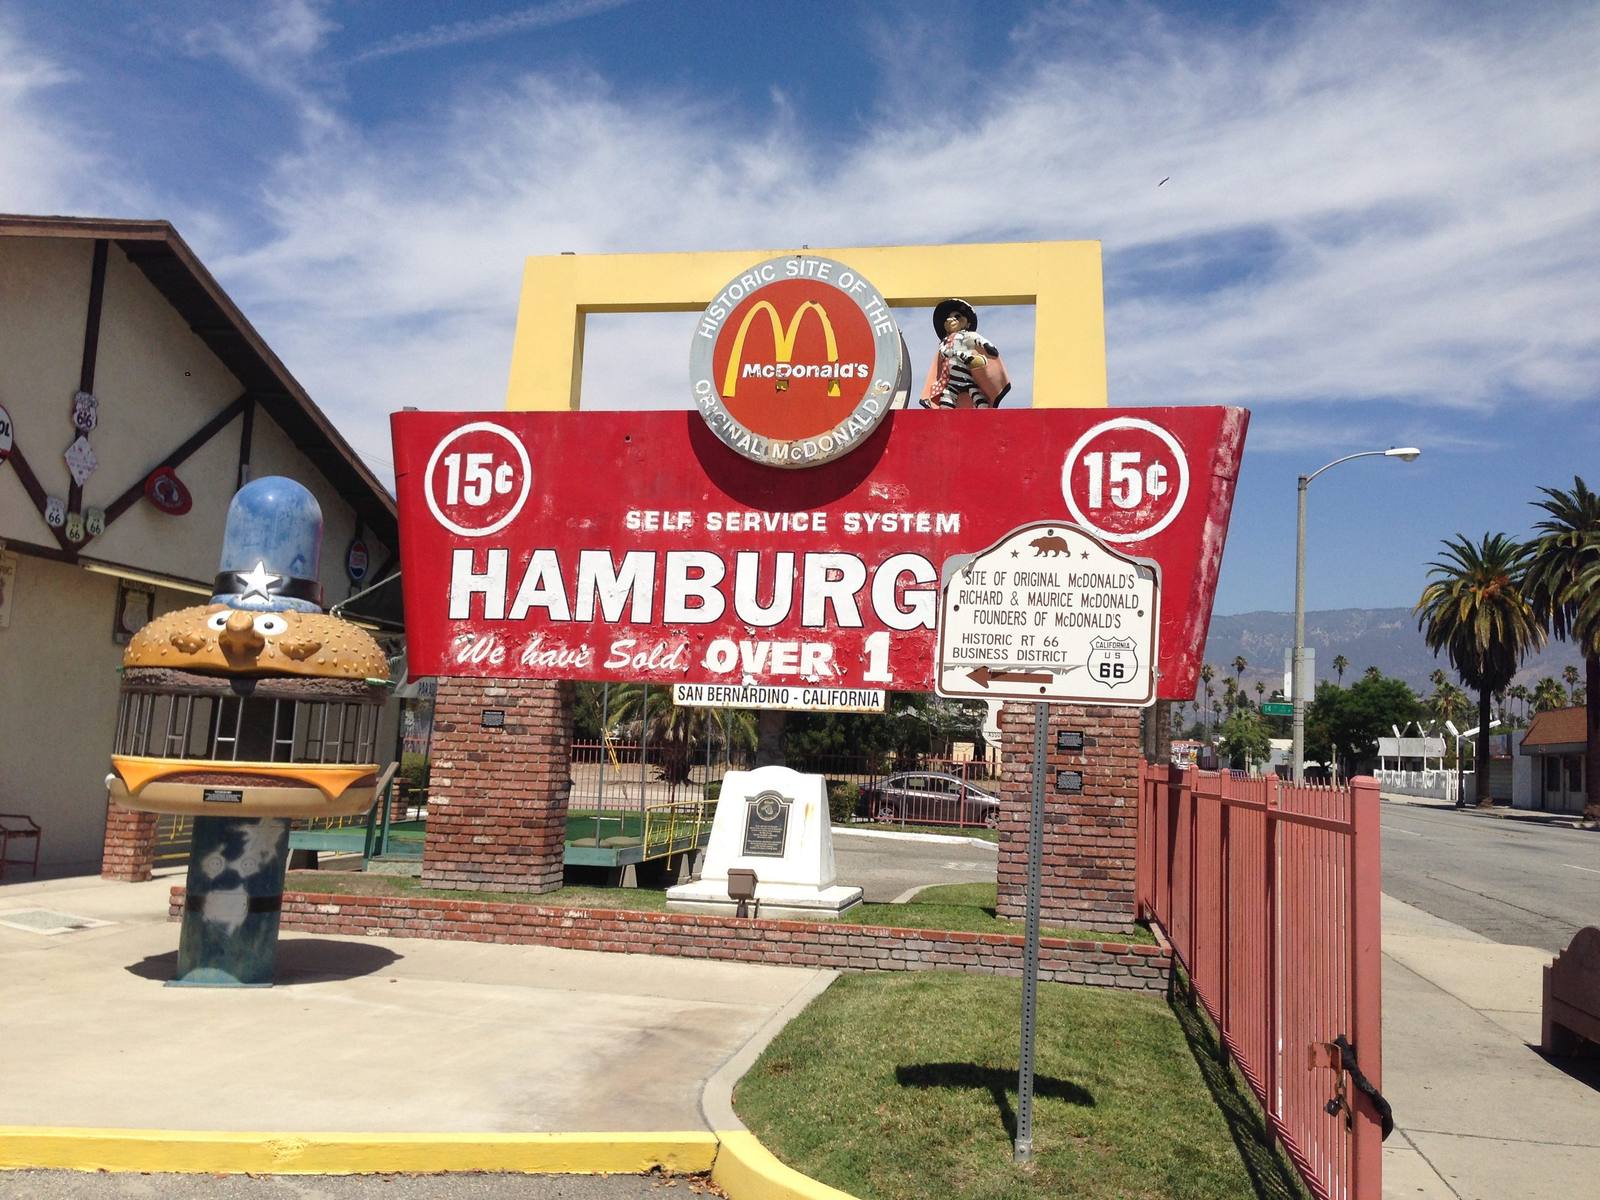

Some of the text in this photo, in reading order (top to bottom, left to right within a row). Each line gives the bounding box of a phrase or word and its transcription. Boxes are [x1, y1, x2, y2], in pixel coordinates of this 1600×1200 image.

[699, 259, 893, 339] HISTORIC SITE OF THE
[742, 362, 869, 379] McDonald's
[76, 411, 92, 428] 66
[694, 379, 762, 456] ORIGINAL
[444, 452, 514, 507] 15¢
[1083, 451, 1168, 509] 15¢
[48, 512, 61, 525] 66
[625, 510, 961, 533] SELF SERVICE SYSTEM
[69, 528, 80, 540] 66
[90, 523, 101, 535] 66
[965, 571, 1135, 589] SITE OF ORIGINAL McDONALD'S
[448, 548, 939, 631] HAMBURG
[959, 590, 1139, 609] RICHARD & MAURICE McDONALD
[973, 610, 1121, 629] FOUNDERS OF McDONALD'S
[962, 632, 1059, 648] HISTORIC RT 66
[1095, 640, 1131, 650] CALIFORNIA
[454, 633, 505, 665] We
[521, 635, 590, 668] have
[704, 639, 834, 677] OVER
[863, 631, 893, 682] 1
[952, 647, 1068, 663] BUSINESS DISTRICT
[1099, 662, 1125, 679] 66
[677, 685, 703, 701] SAN
[707, 686, 789, 704] BERNARDINO
[802, 689, 880, 707] CALIFORNIA
